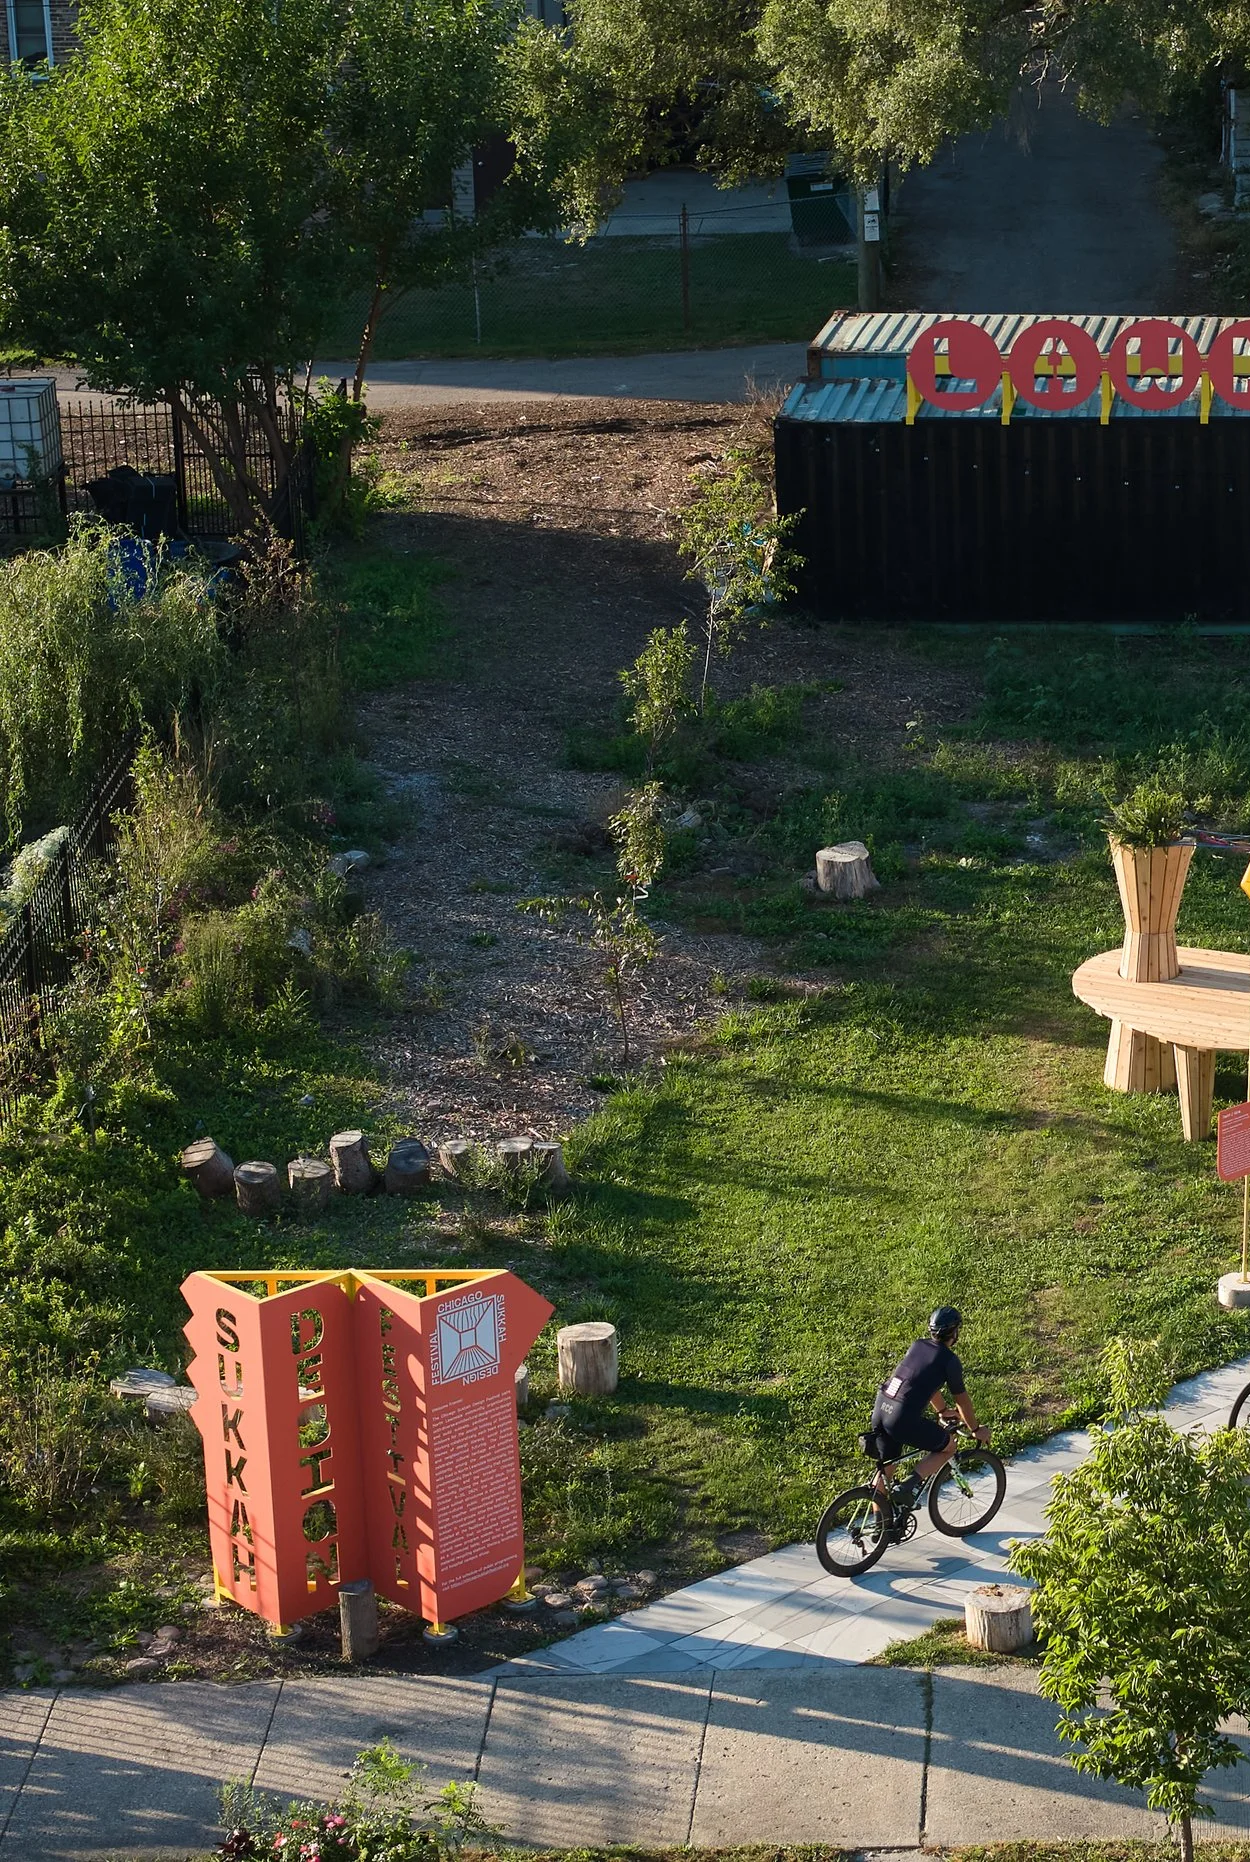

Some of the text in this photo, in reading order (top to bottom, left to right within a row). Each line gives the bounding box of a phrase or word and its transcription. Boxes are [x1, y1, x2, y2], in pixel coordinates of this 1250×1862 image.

[437, 1291, 482, 1313] CHICAGO
[497, 1294, 507, 1342] SUKKAH
[429, 1329, 440, 1386] FESTIVAL
[462, 1365, 499, 1386] DESIGN
[215, 1307, 257, 1592] SUKKAH
[379, 1307, 409, 1590] FESTIVAL
